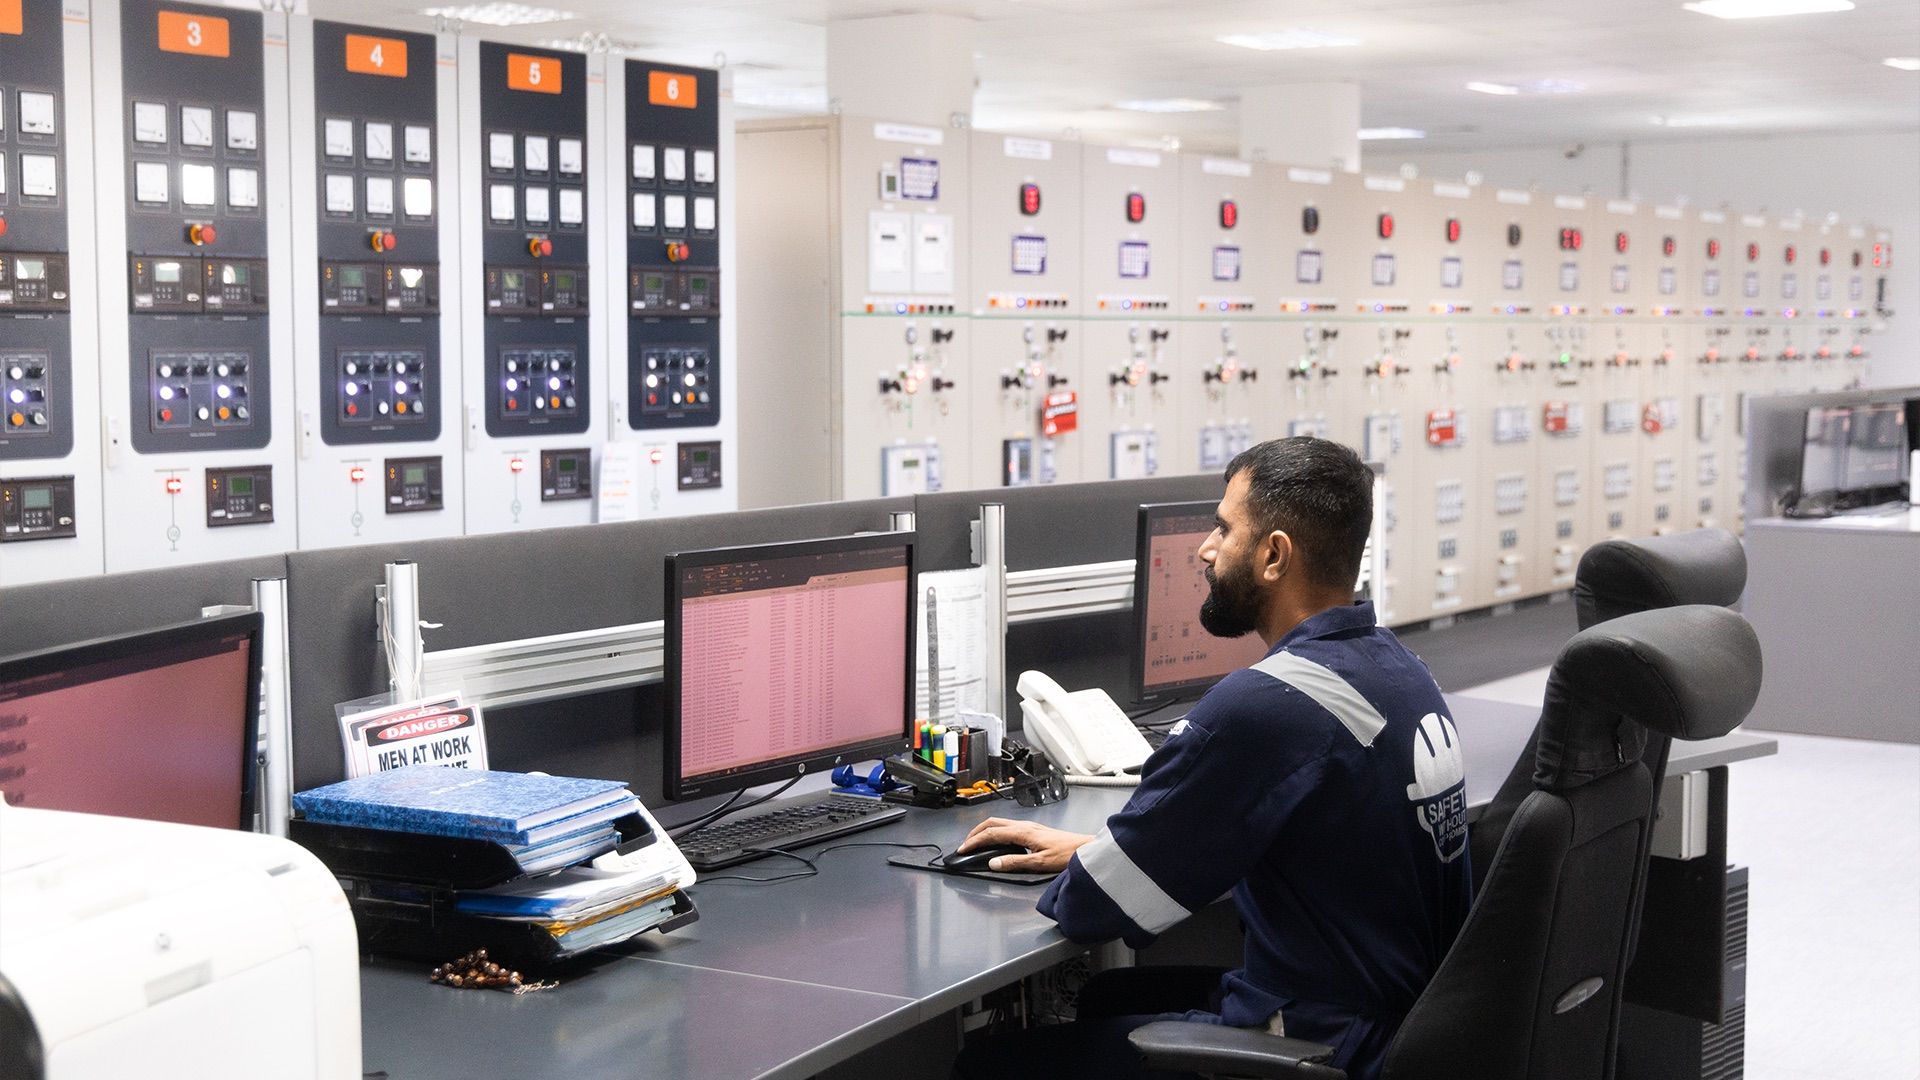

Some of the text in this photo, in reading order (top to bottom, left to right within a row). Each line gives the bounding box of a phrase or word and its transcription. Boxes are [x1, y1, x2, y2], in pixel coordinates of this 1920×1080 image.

[187, 21, 202, 47] 3
[369, 44, 383, 68] 4
[528, 62, 541, 85] 5
[667, 78, 679, 100] 6
[386, 715, 462, 739] DANGER
[378, 748, 408, 772] MEN
[412, 744, 427, 765] AT
[431, 735, 472, 760] WORK
